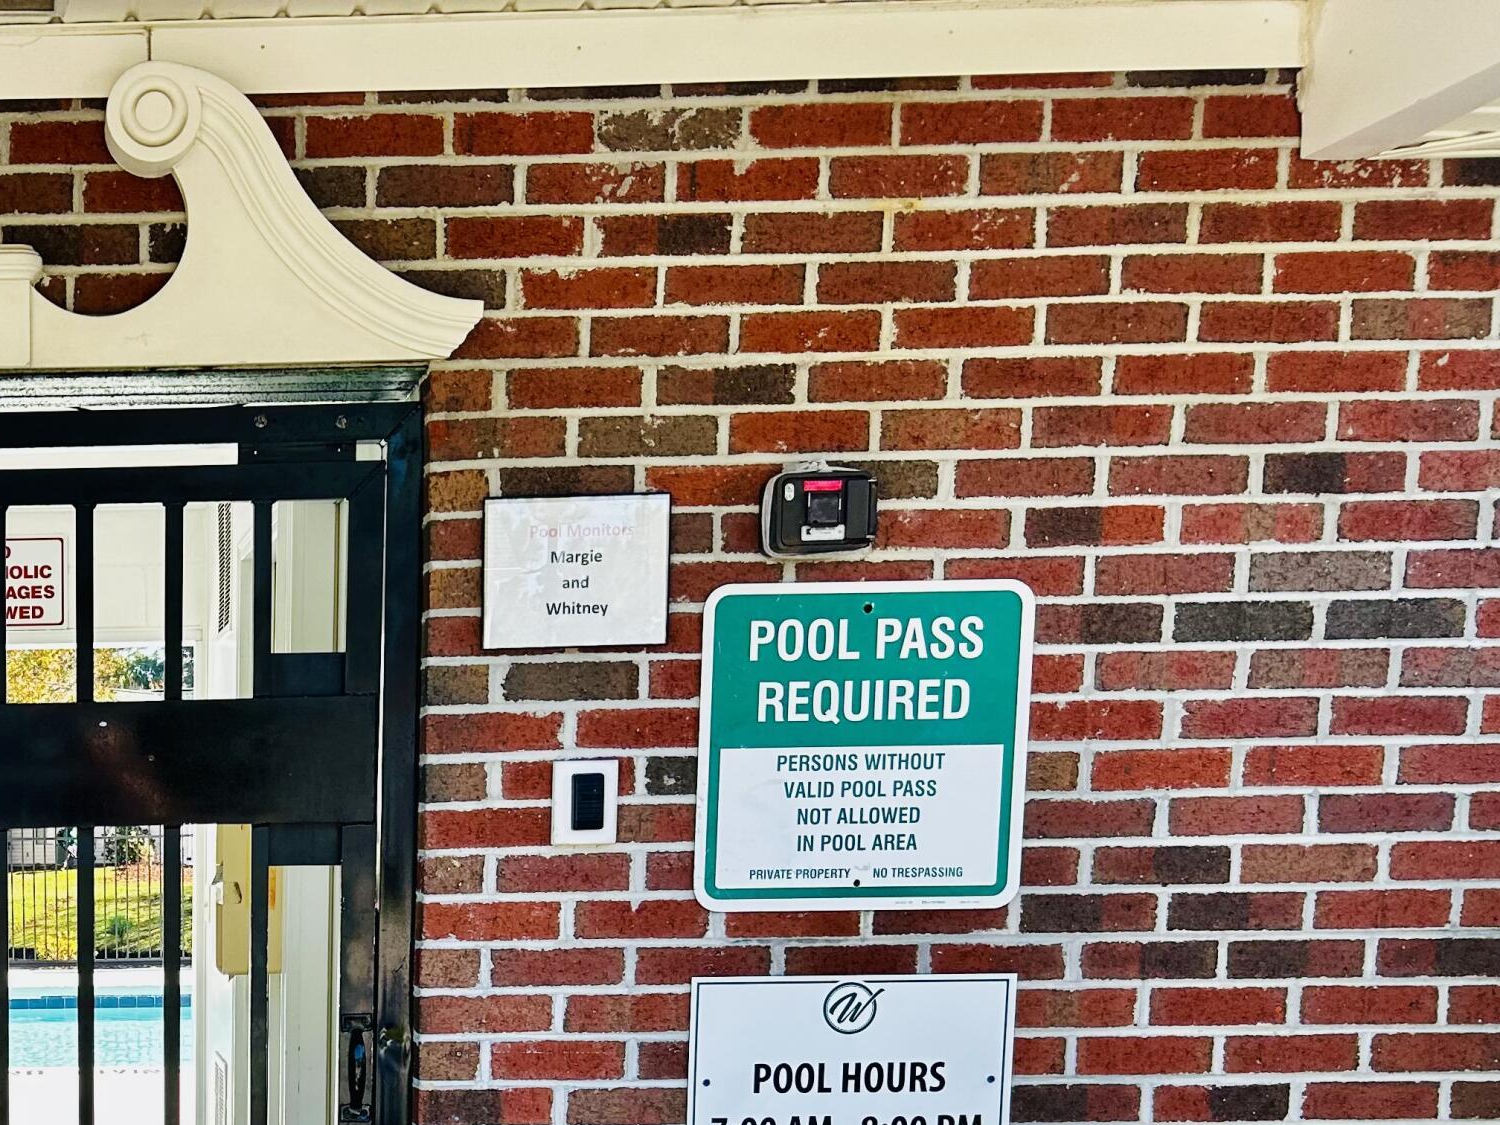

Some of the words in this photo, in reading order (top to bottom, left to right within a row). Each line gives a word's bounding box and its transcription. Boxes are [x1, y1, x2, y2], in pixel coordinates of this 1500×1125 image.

[529, 524, 562, 538] Pool
[567, 522, 635, 538] Monitors
[550, 549, 603, 565] Margie
[562, 575, 589, 588] and
[546, 601, 608, 616] Whitney
[749, 618, 860, 662] POOL
[875, 615, 984, 660] PASS
[757, 678, 970, 725] REQUIRED
[776, 753, 858, 772] PERSONS
[864, 752, 946, 771] WITHOUT
[784, 781, 834, 799] VALID
[841, 780, 886, 798] POOL
[893, 779, 937, 797] PASS
[796, 808, 832, 826] NOT
[836, 807, 921, 825] ALLOWED
[796, 834, 814, 852] IN
[820, 833, 866, 852] POOL
[872, 833, 918, 851] AREA
[749, 868, 792, 880] PRIVATE
[795, 867, 851, 880] PROPERTY
[873, 867, 888, 878] NO
[891, 866, 963, 878] TRESPASSING
[753, 1062, 832, 1094] POOL
[841, 1061, 946, 1093] HOURS
